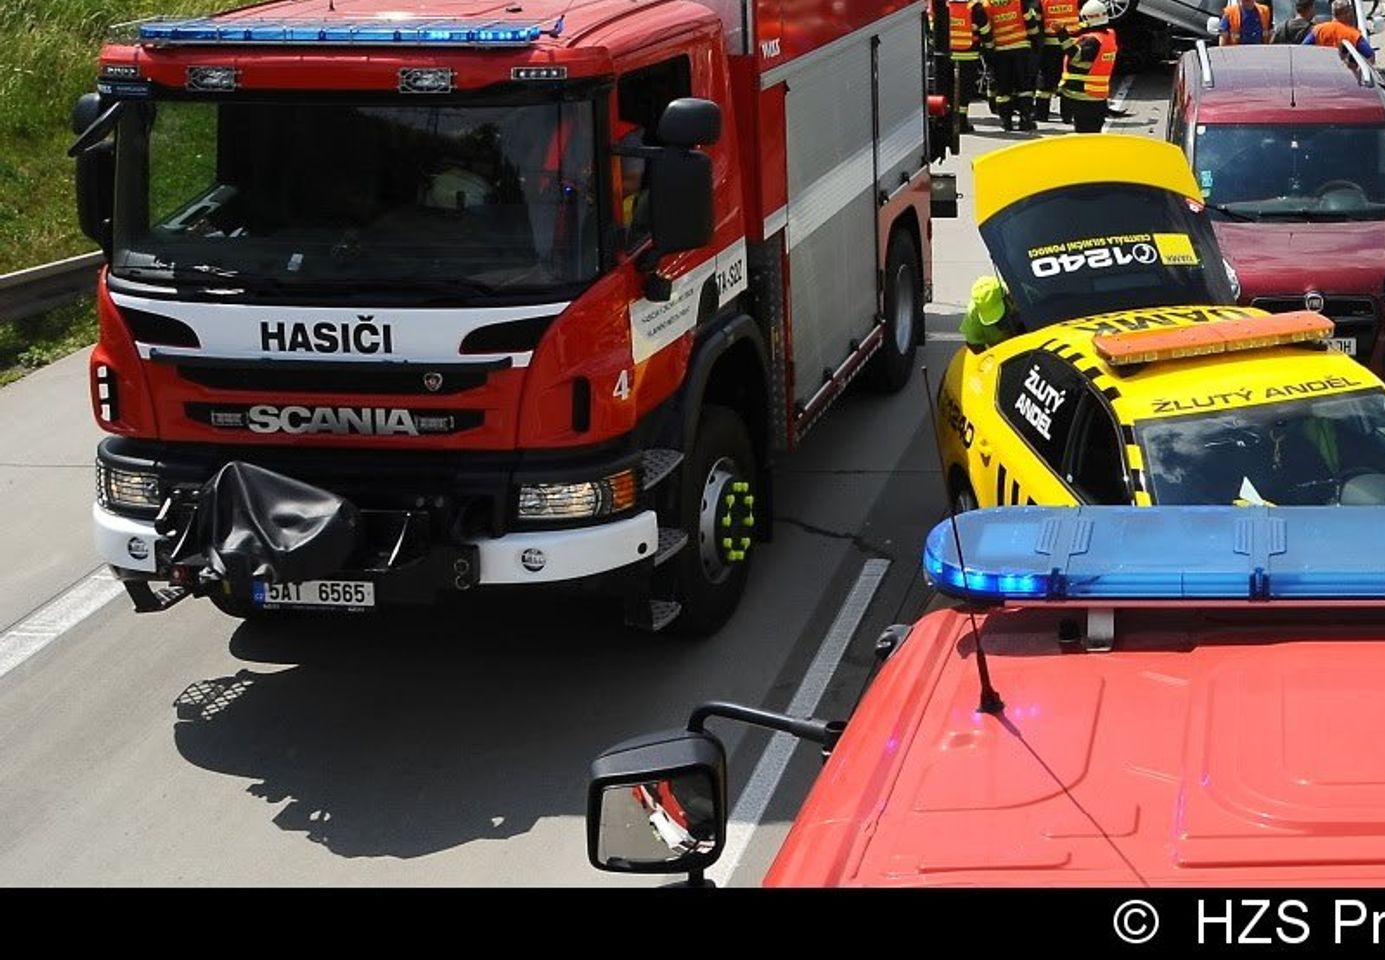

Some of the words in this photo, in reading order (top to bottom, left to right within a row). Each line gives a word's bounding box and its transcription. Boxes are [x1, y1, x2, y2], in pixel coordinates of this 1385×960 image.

[1030, 247, 1134, 278] 1240
[260, 315, 393, 354] HASIČI
[612, 369, 631, 401] 4
[1023, 364, 1067, 413] ŽLUTÝ
[1151, 387, 1254, 413] ŽLUTÝ
[1265, 375, 1363, 399] ANDĚL
[248, 405, 420, 436] SCANIA
[1014, 393, 1052, 441] ANDĚL
[318, 582, 365, 603] 6565
